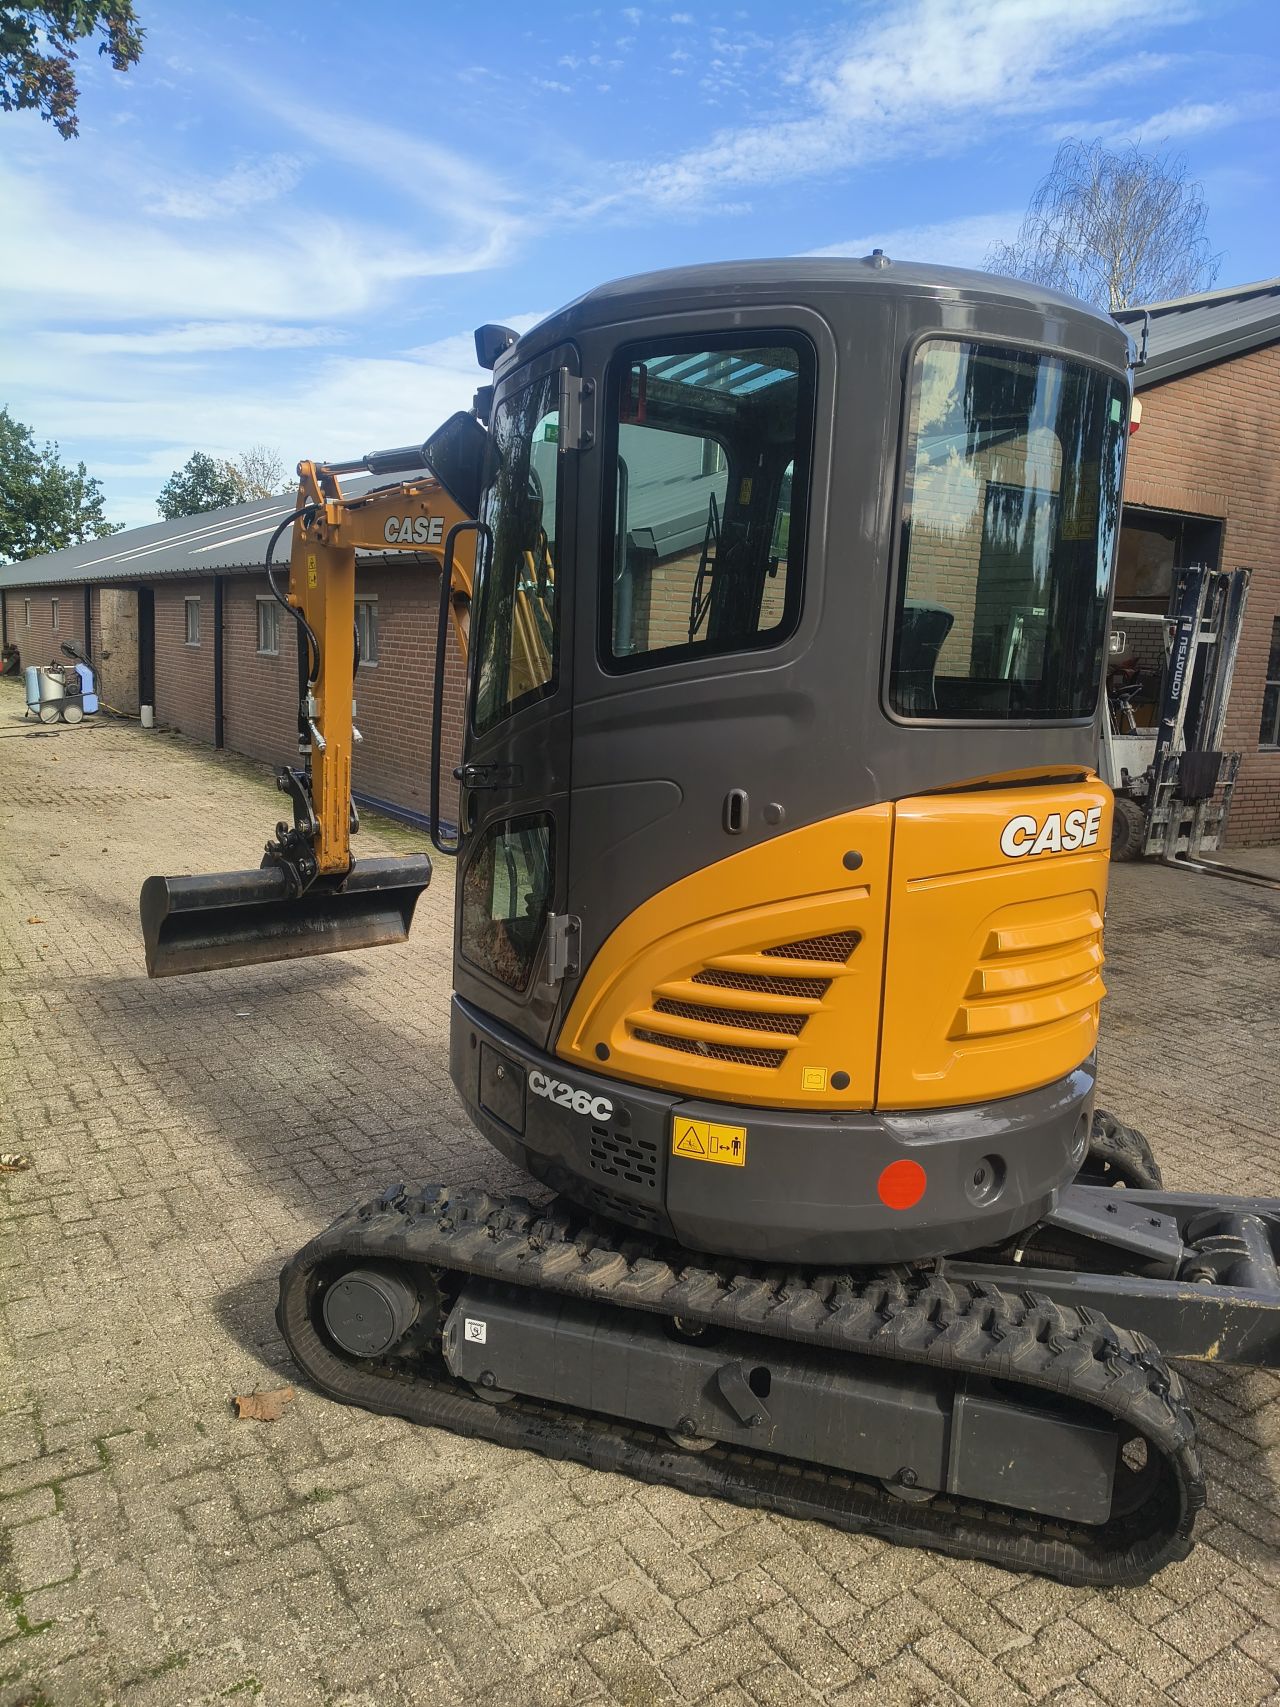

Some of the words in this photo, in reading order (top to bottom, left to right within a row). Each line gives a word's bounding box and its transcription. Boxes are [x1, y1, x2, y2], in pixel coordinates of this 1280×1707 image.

[384, 516, 445, 544] CASE
[1171, 636, 1188, 699] KOMATSU
[1000, 806, 1102, 858] CASE
[528, 1070, 613, 1121] CX26C
